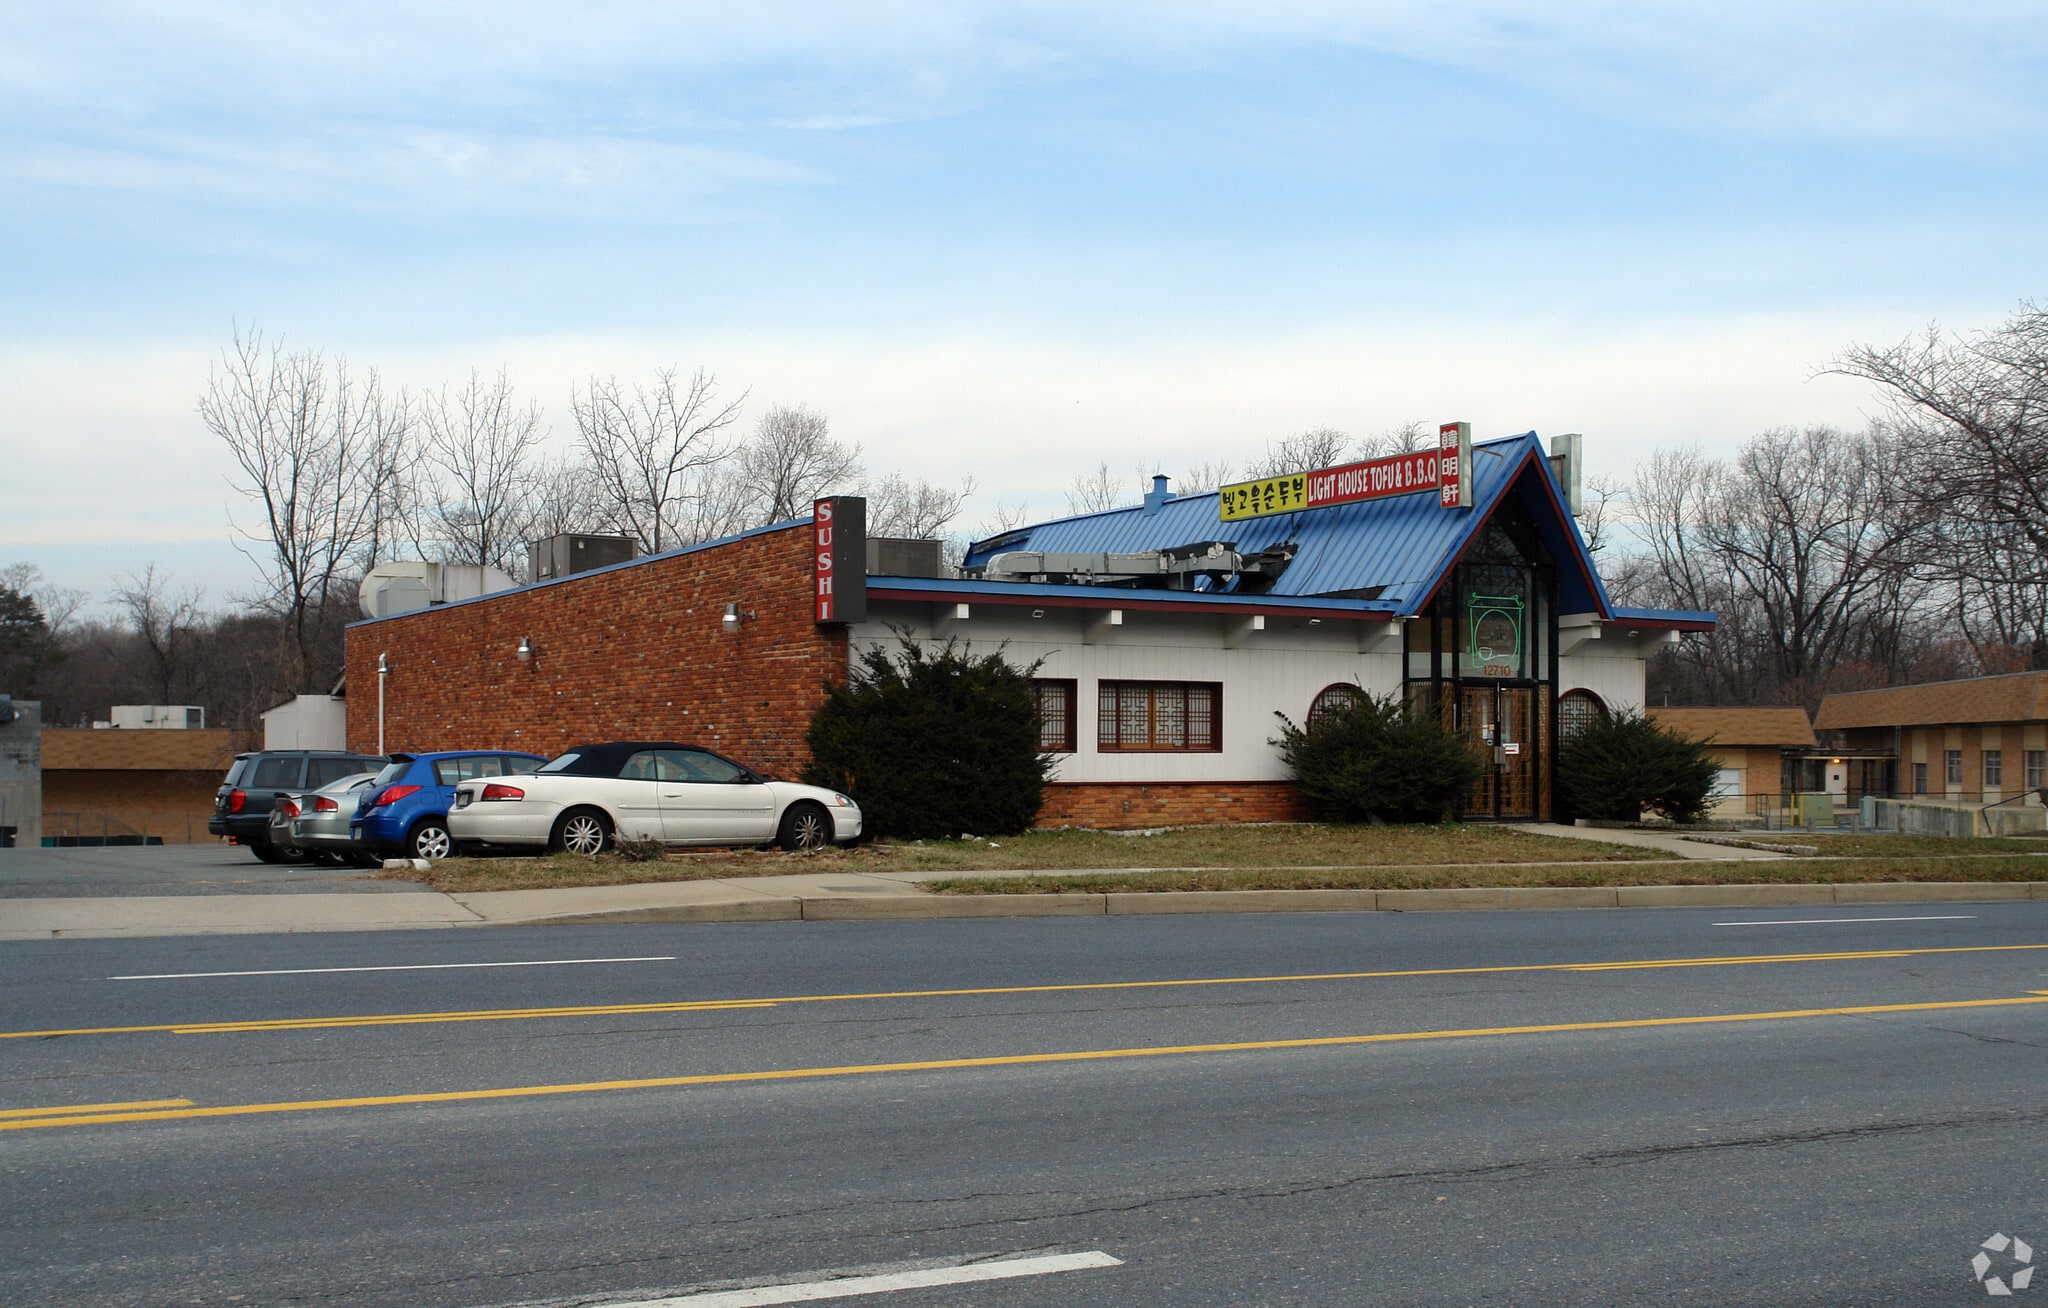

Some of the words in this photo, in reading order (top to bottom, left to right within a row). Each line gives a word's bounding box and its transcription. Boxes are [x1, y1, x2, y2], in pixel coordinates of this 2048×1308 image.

[1308, 474, 1335, 502] LIGHT
[1338, 469, 1368, 496] HOUSE
[1441, 429, 1459, 504] 韓明軒
[818, 503, 832, 619] SUSHI
[1483, 664, 1511, 677] 12710
